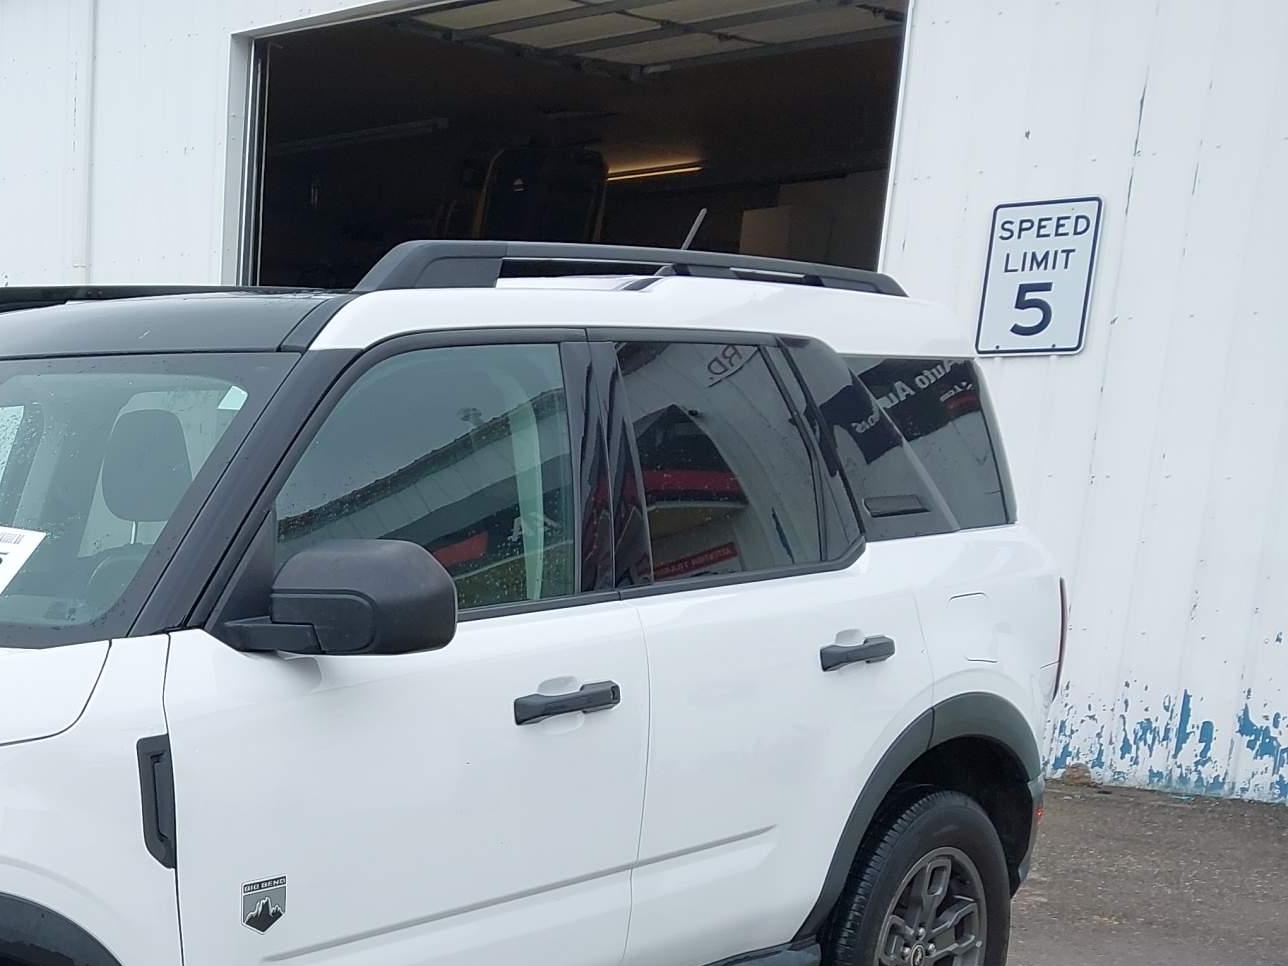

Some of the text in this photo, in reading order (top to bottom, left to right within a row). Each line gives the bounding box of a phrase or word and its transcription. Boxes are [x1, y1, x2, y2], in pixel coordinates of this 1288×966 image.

[998, 214, 1091, 241] SPEED
[1003, 248, 1076, 273] LIMIT
[1009, 281, 1054, 337] 5
